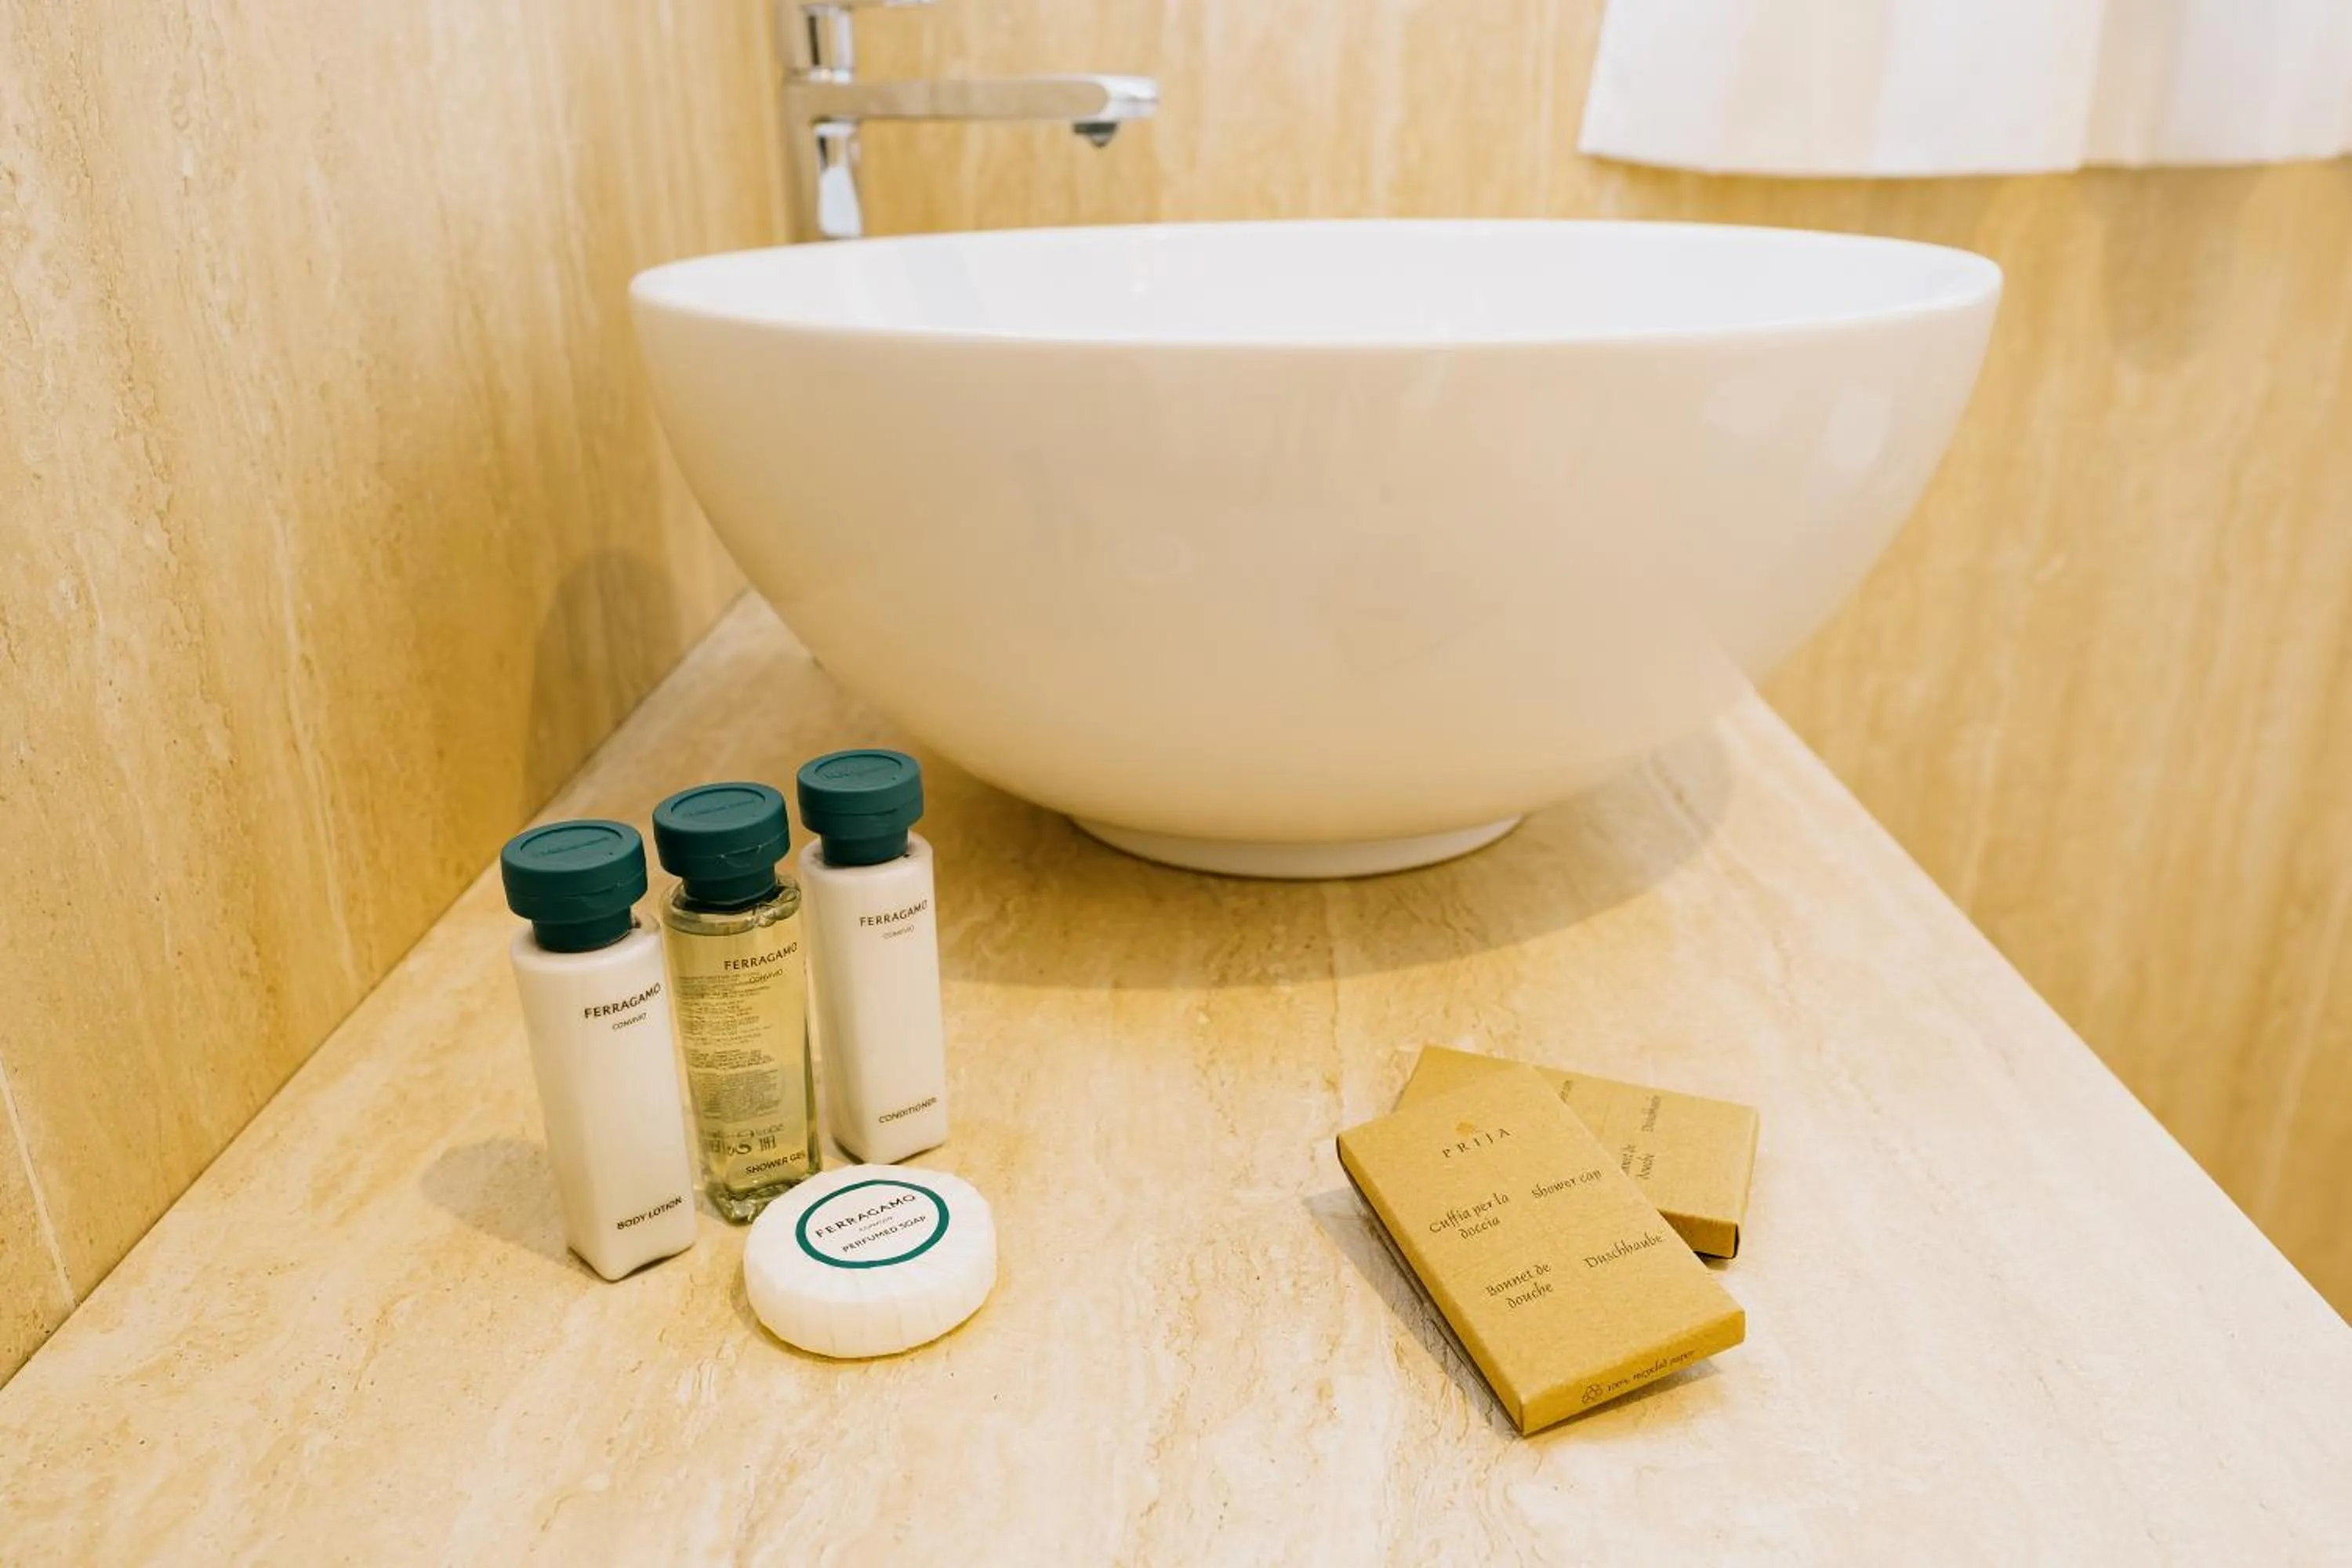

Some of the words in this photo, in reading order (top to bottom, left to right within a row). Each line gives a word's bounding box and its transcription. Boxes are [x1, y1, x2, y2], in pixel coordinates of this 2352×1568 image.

[858, 899, 928, 927] FERRAGAMO
[724, 942, 798, 971] FERRAGAMO
[584, 982, 661, 1019] FERRAGAMO
[878, 1097, 937, 1123] CONDITIONER
[746, 1156, 789, 1174] SHOWER
[789, 1149, 806, 1162] GEL
[1580, 1168, 1602, 1183] cap
[617, 1213, 647, 1229] BODY
[648, 1196, 681, 1218] LOTION
[815, 1193, 916, 1238] FERRAGAMO
[1428, 1207, 1472, 1234] Cuffia
[1472, 1201, 1493, 1216] per
[1493, 1192, 1509, 1205] la
[842, 1226, 898, 1252] PERFUMED
[898, 1215, 926, 1230] SOAP
[1459, 1217, 1501, 1240] doccia
[1582, 1232, 1662, 1268] Duschhaube
[1485, 1269, 1534, 1297] Bonnet
[1534, 1263, 1552, 1276] de
[1505, 1281, 1553, 1309] douche
